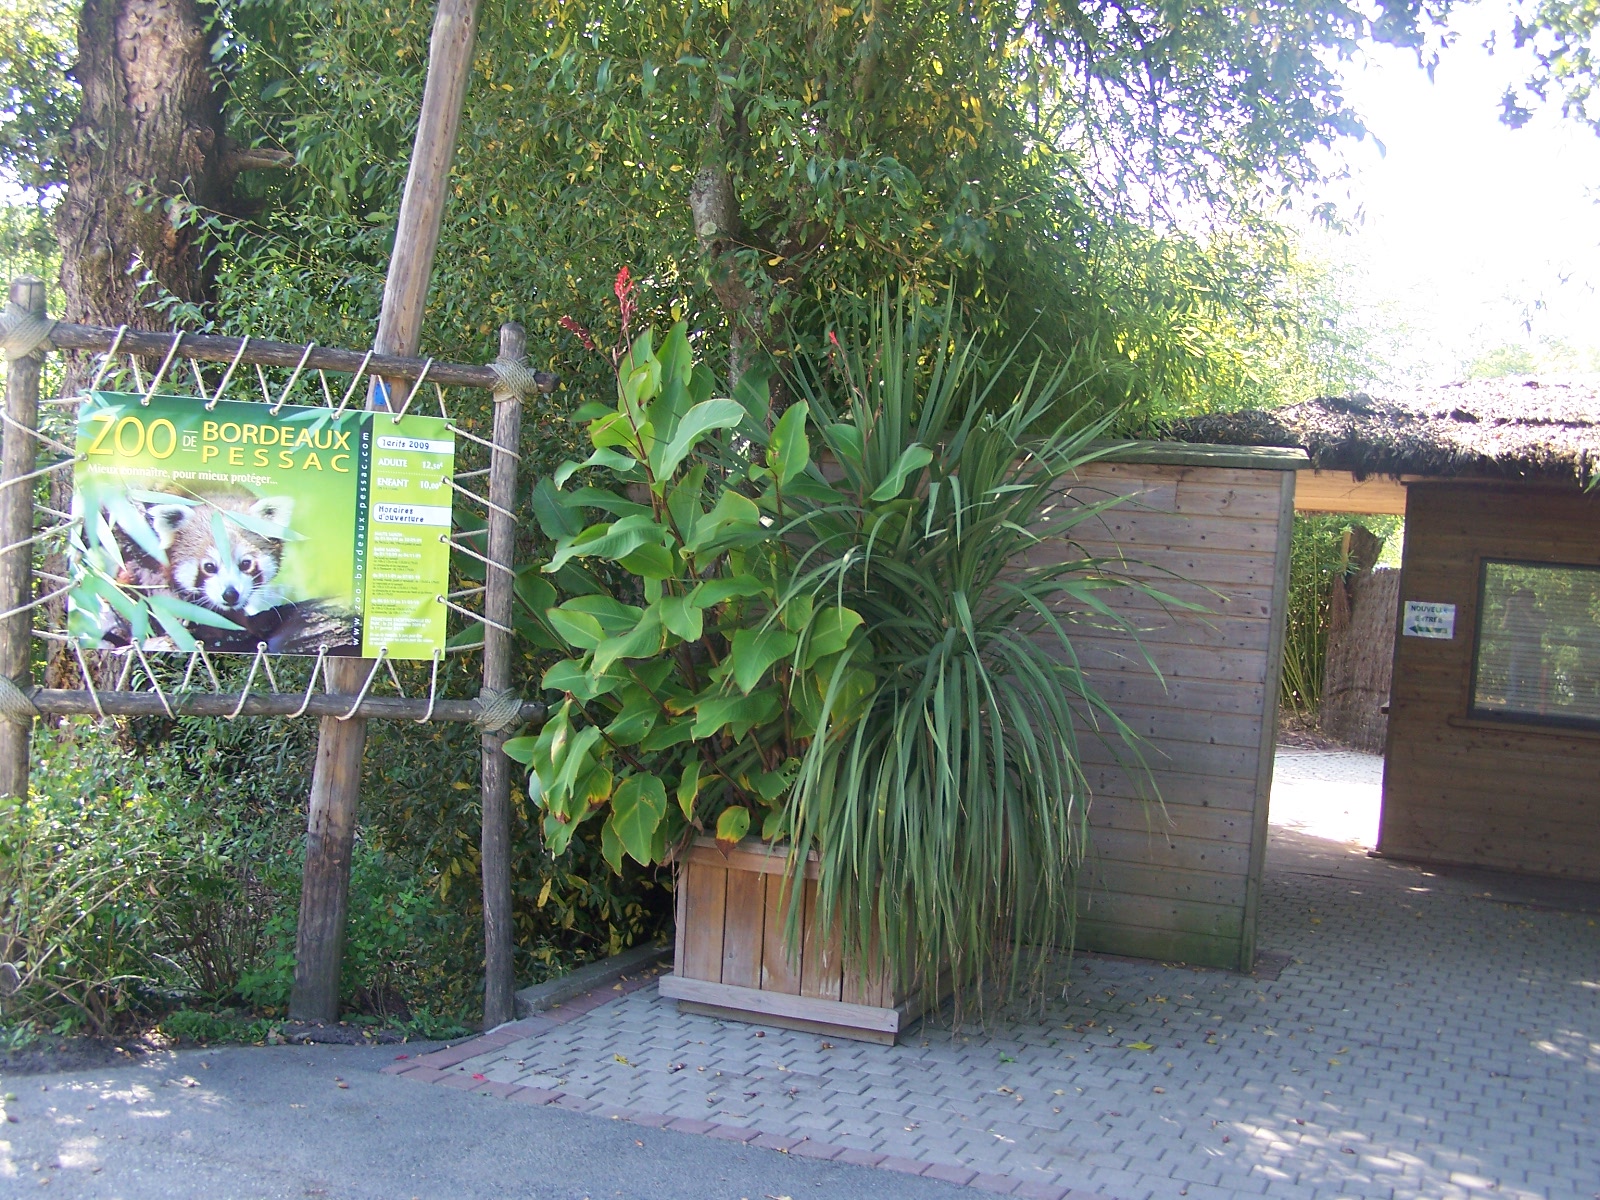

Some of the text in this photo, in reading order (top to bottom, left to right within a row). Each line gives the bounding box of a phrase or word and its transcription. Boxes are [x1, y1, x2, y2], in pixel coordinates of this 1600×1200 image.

[89, 415, 351, 459] ZOO DE BORDEAUX
[409, 440, 430, 450] 2009
[202, 445, 350, 473] PESSAC
[378, 458, 408, 468] ADULTE
[172, 470, 197, 480] pour
[198, 470, 228, 481] mieux
[377, 477, 409, 488] ENFANT
[379, 506, 413, 514] Horaires
